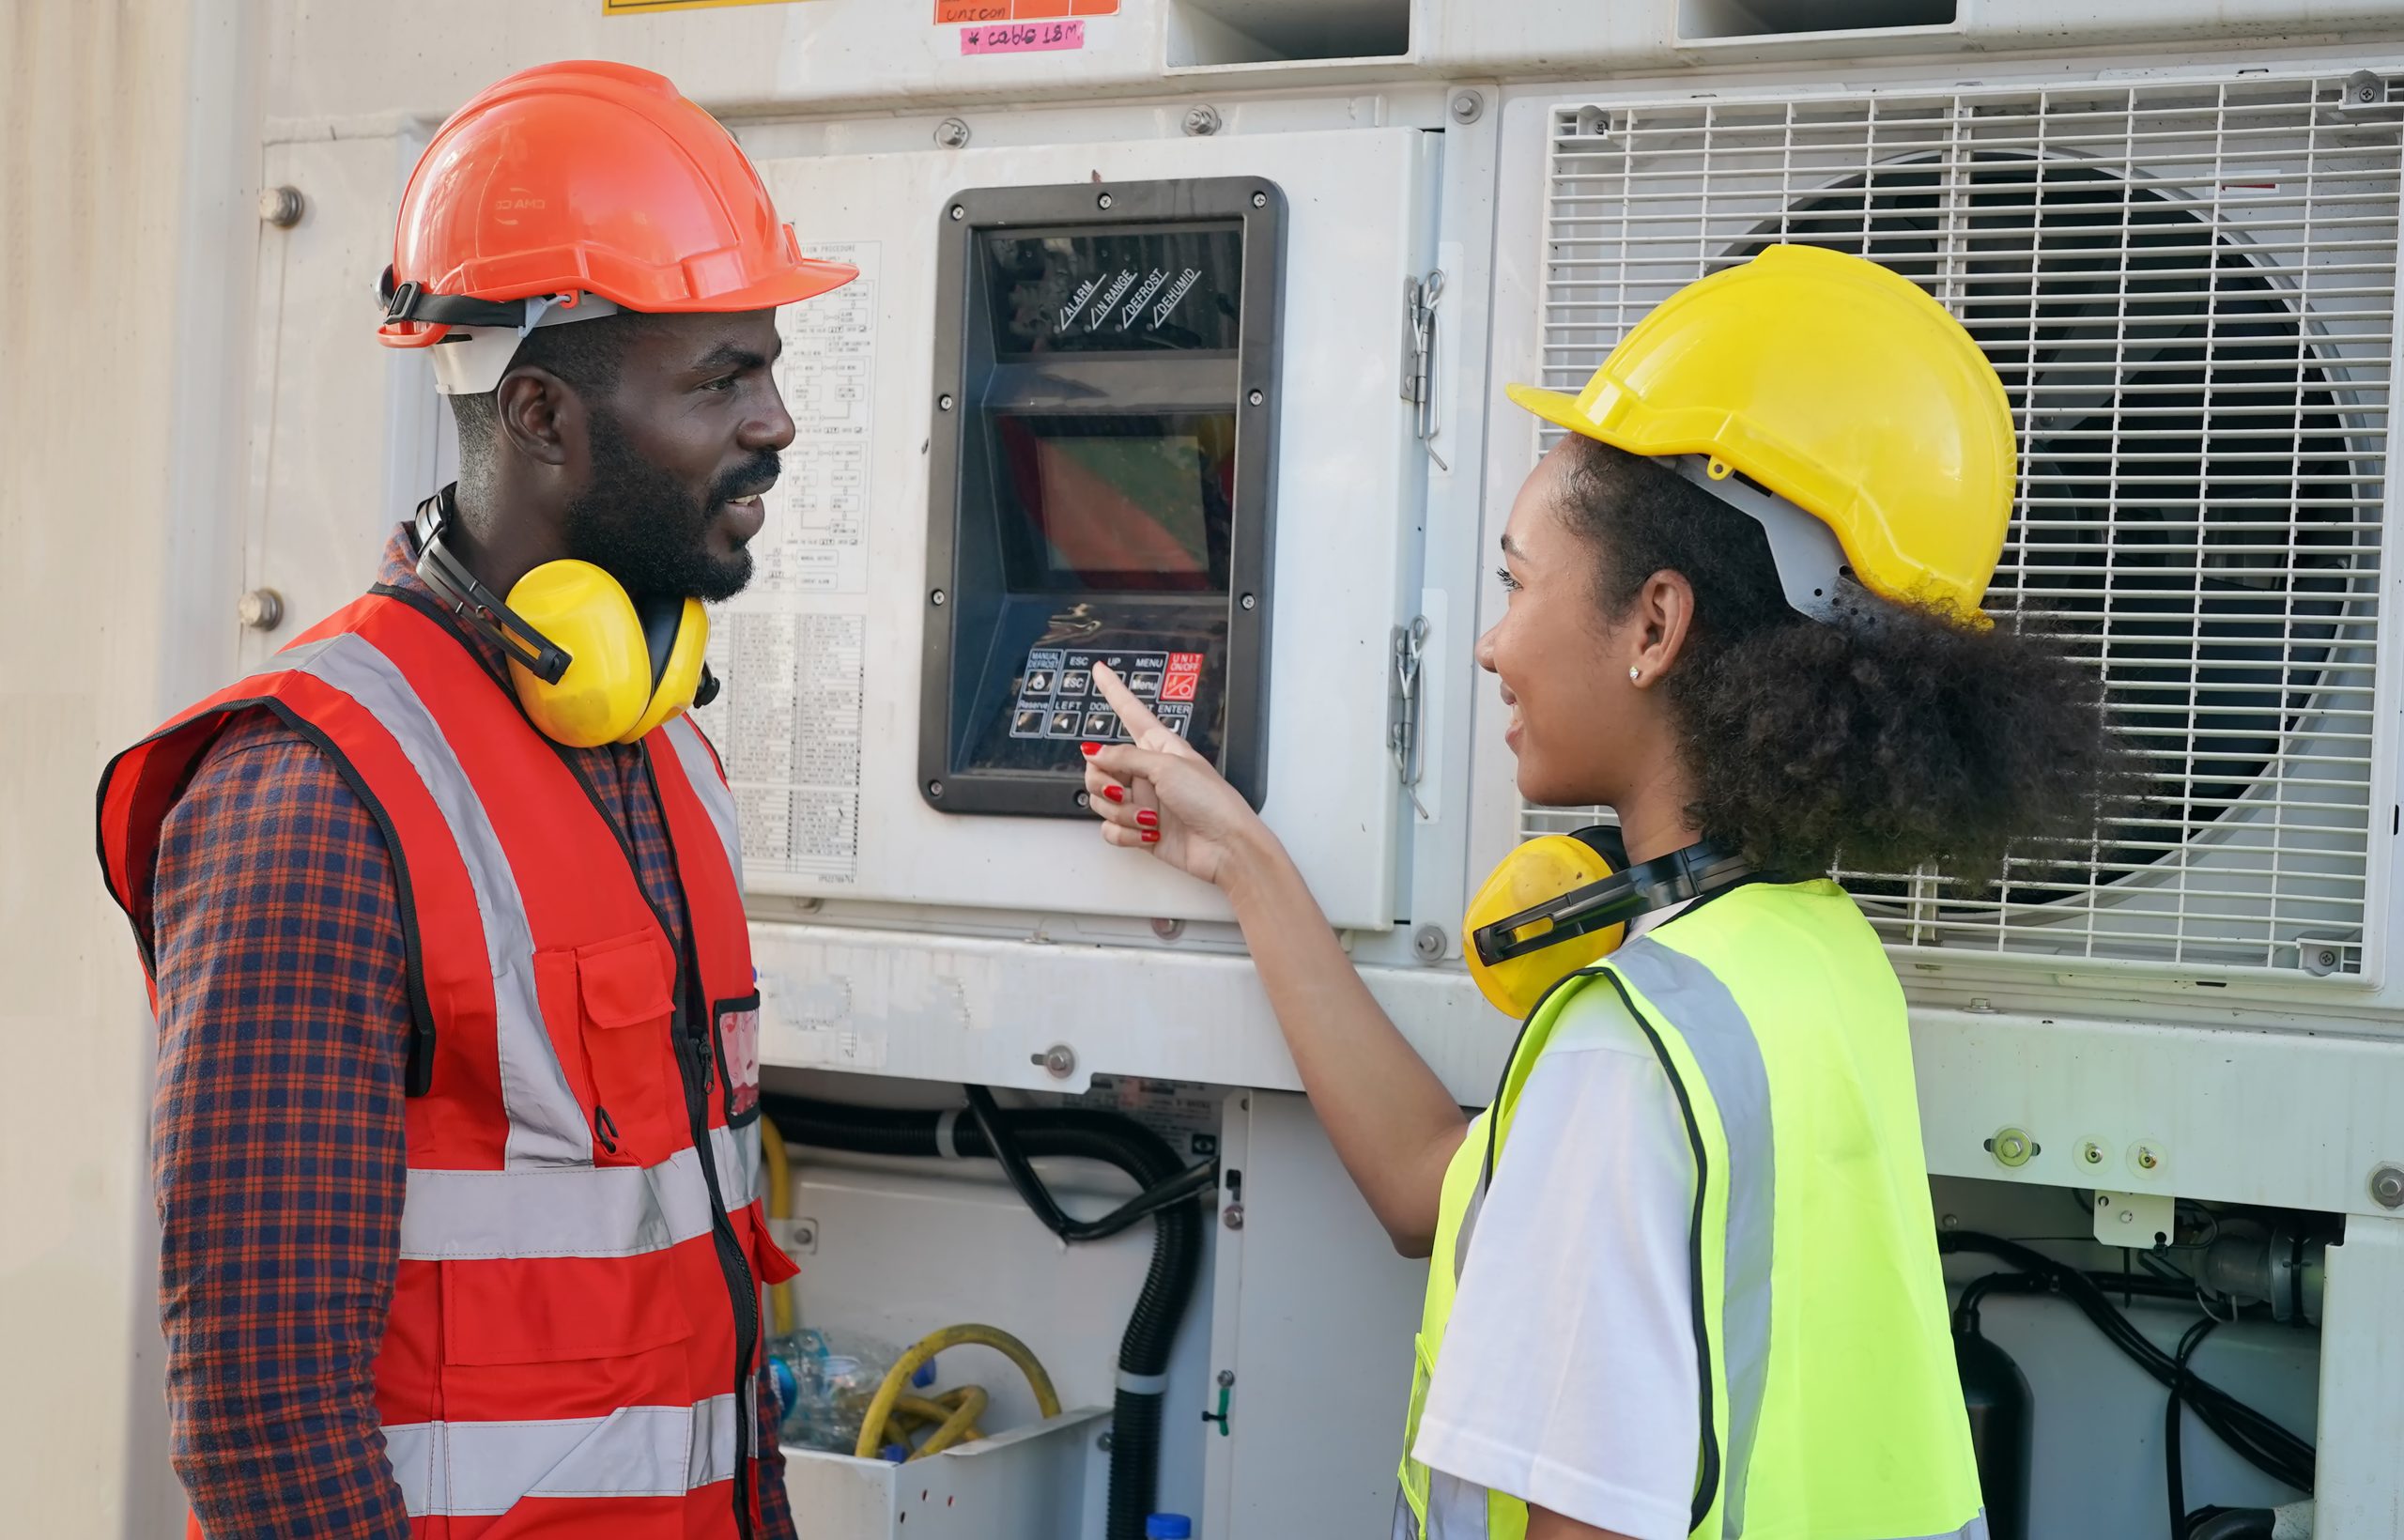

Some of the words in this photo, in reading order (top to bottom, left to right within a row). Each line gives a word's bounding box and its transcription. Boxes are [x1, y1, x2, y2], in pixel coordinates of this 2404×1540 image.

[1094, 300, 1108, 316] IN
[1102, 269, 1133, 304] RANGE
[1125, 268, 1163, 316] DEFROST
[1156, 268, 1195, 315] DEHUMID
[1065, 280, 1094, 317] ALARM
[1070, 656, 1089, 666] ESC
[1107, 657, 1121, 667] UP
[1135, 658, 1163, 668] MENU
[1173, 654, 1202, 662] UNIT
[1028, 659, 1058, 668] DEFROST
[1171, 662, 1199, 671] ON/OFF
[1063, 677, 1085, 688] ESC
[1018, 700, 1049, 709] Reserve
[1055, 701, 1082, 710] LEFT
[1089, 701, 1113, 711] DOW
[1158, 705, 1190, 714] ENTER
